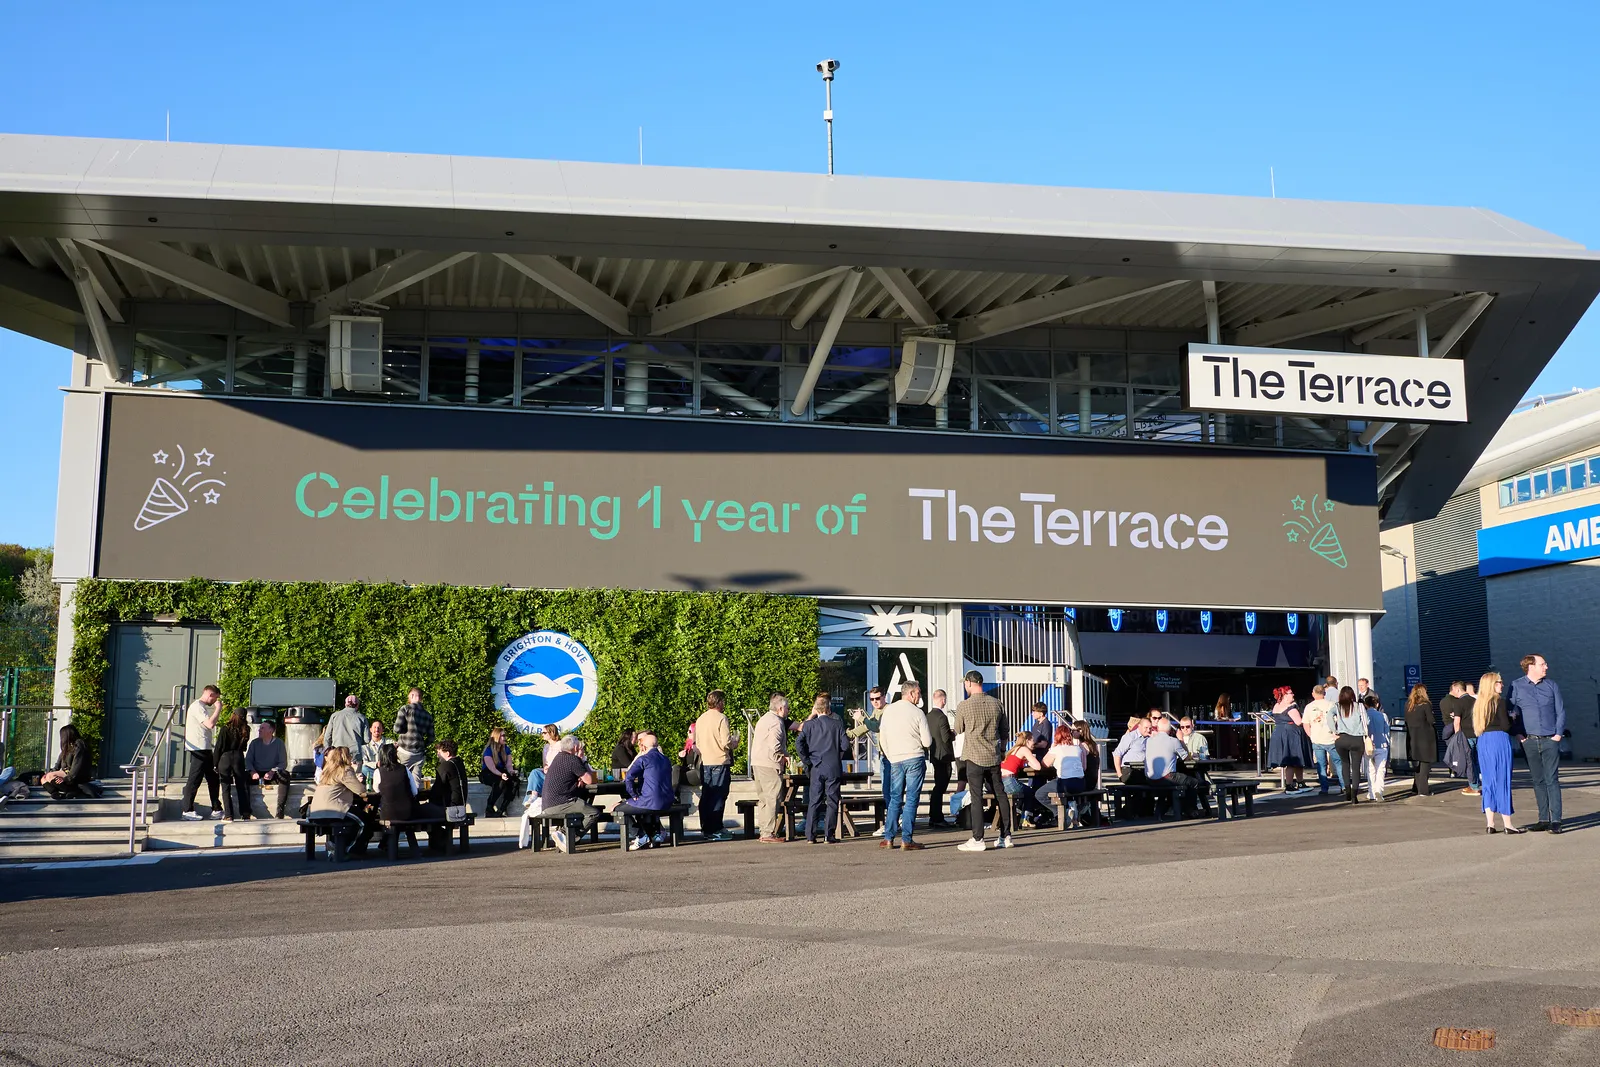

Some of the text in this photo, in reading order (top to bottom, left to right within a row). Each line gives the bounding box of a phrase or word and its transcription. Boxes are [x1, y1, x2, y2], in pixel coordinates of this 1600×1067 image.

[1203, 355, 1452, 410] The Terrace
[296, 472, 867, 543] Celebrating 1 year of
[908, 487, 1230, 552] The Terrace
[503, 635, 588, 664] BRIGHTON & HOVE
